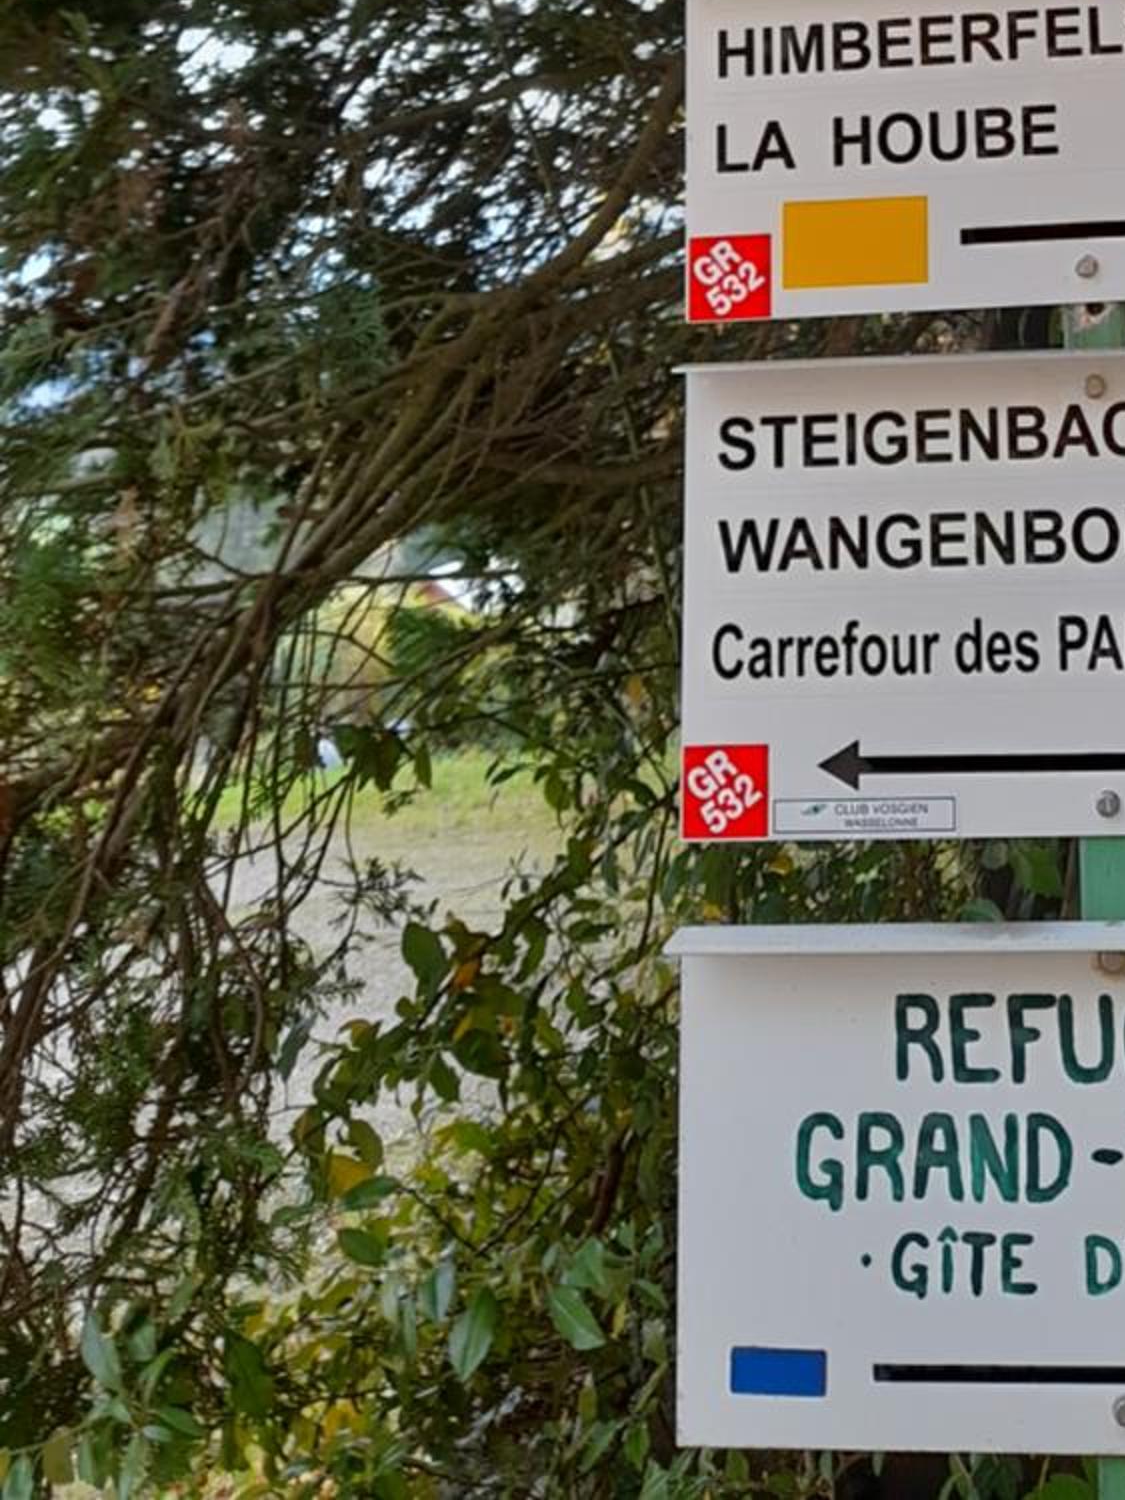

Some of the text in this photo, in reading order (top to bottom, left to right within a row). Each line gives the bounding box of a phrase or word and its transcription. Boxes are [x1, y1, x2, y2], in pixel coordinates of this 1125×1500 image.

[716, 120, 797, 174] LA
[833, 104, 1060, 167] HOUBE
[694, 240, 742, 286] GR
[706, 261, 765, 316] 532
[712, 619, 941, 680] Carrefour
[955, 617, 1040, 675] des
[688, 750, 738, 799] GR
[700, 773, 762, 834] 532
[834, 803, 869, 816] CLUB
